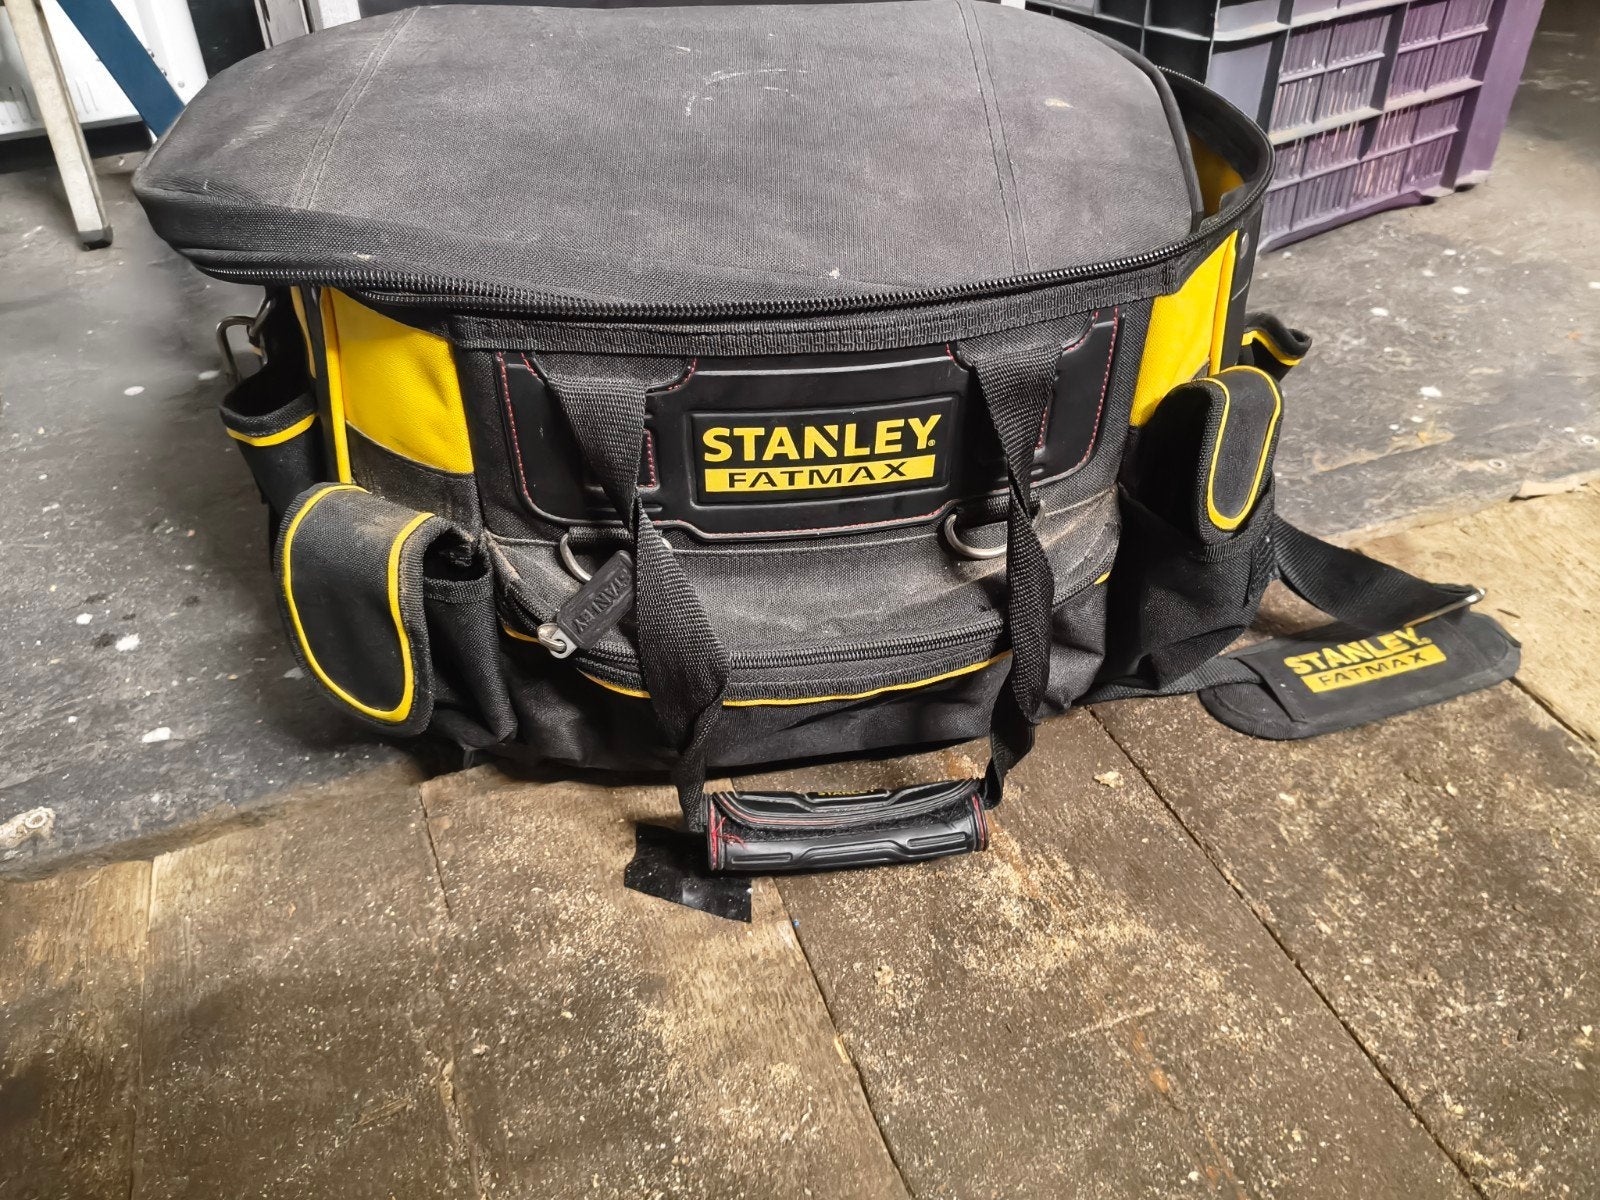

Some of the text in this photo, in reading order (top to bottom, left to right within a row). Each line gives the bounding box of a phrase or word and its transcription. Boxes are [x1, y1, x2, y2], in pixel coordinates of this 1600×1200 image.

[702, 414, 942, 462] STANLEY
[728, 461, 908, 488] FATMAX
[1284, 627, 1423, 675] STANLEY
[1318, 652, 1427, 686] FATMAX
